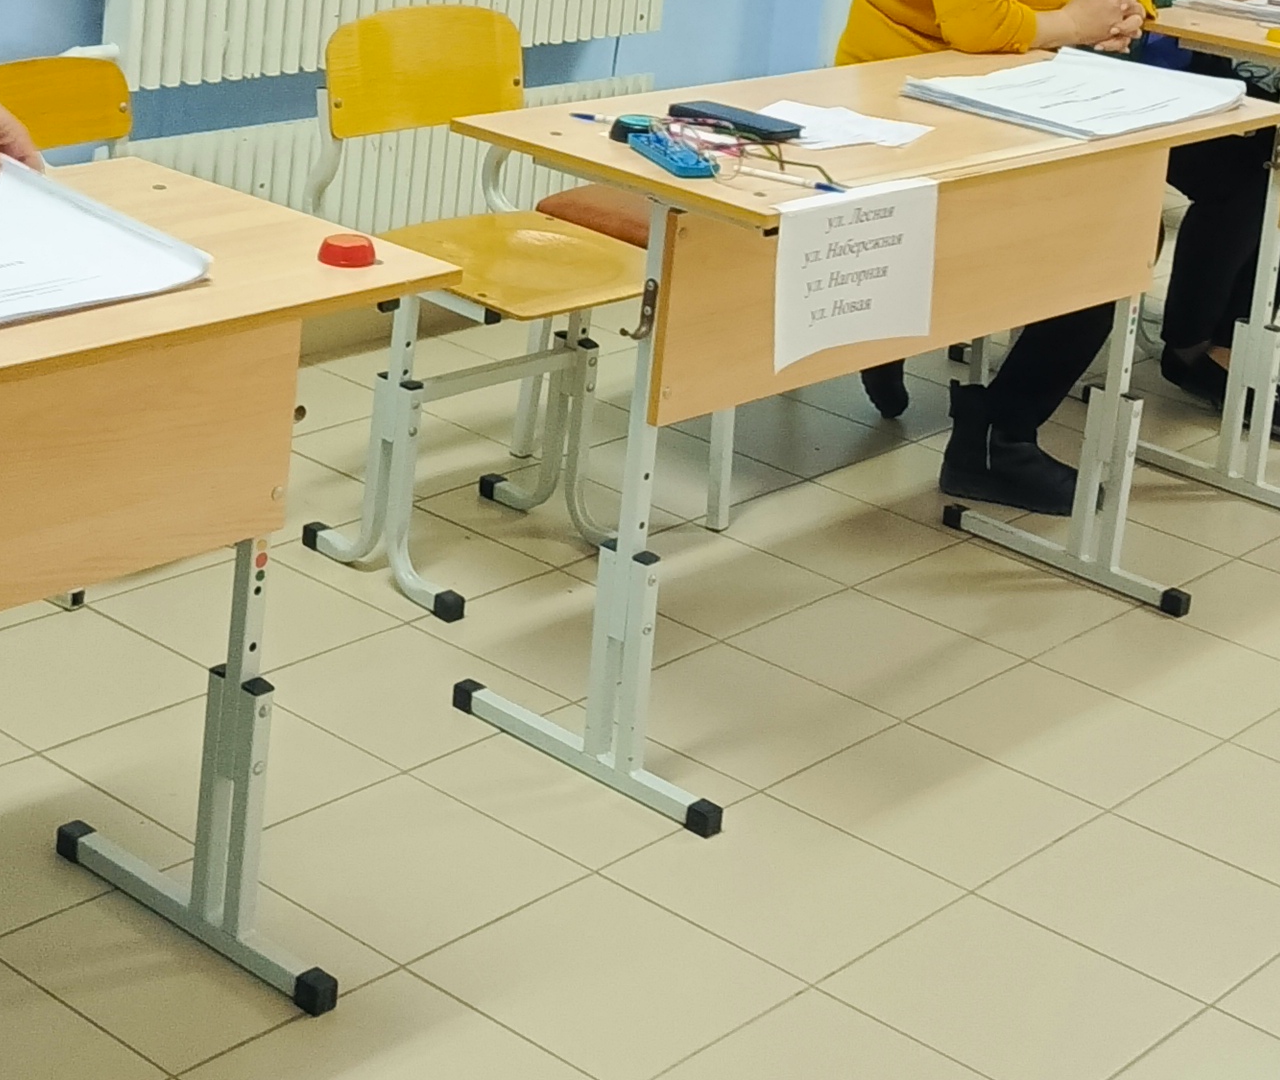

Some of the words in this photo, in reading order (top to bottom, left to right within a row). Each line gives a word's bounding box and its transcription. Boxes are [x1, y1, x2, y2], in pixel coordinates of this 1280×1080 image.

[825, 216, 845, 234] ул.
[849, 206, 896, 225] Лесная
[802, 250, 823, 269] ул.
[826, 232, 904, 260] Набережная
[804, 280, 824, 299] ул.
[827, 265, 889, 289] Нагорная
[809, 308, 828, 327] ул.
[831, 298, 873, 317] Новая
